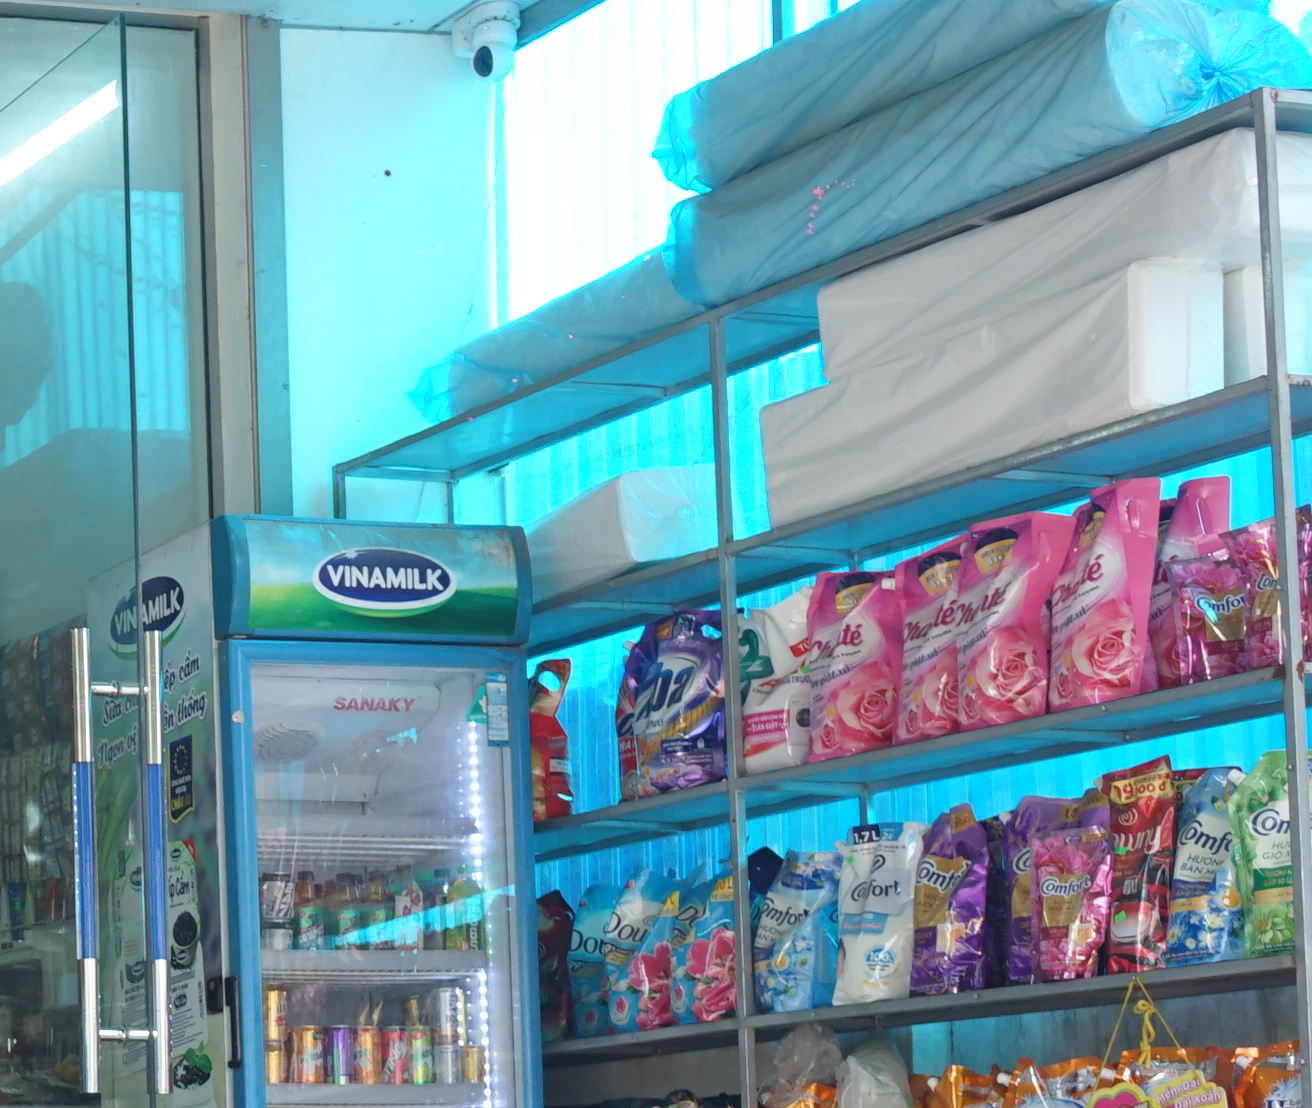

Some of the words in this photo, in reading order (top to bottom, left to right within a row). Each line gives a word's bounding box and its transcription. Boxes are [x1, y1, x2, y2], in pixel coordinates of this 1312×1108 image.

[328, 562, 443, 593] VINAMILK
[334, 696, 415, 713] SANAKY
[1040, 873, 1091, 897] Comfort
